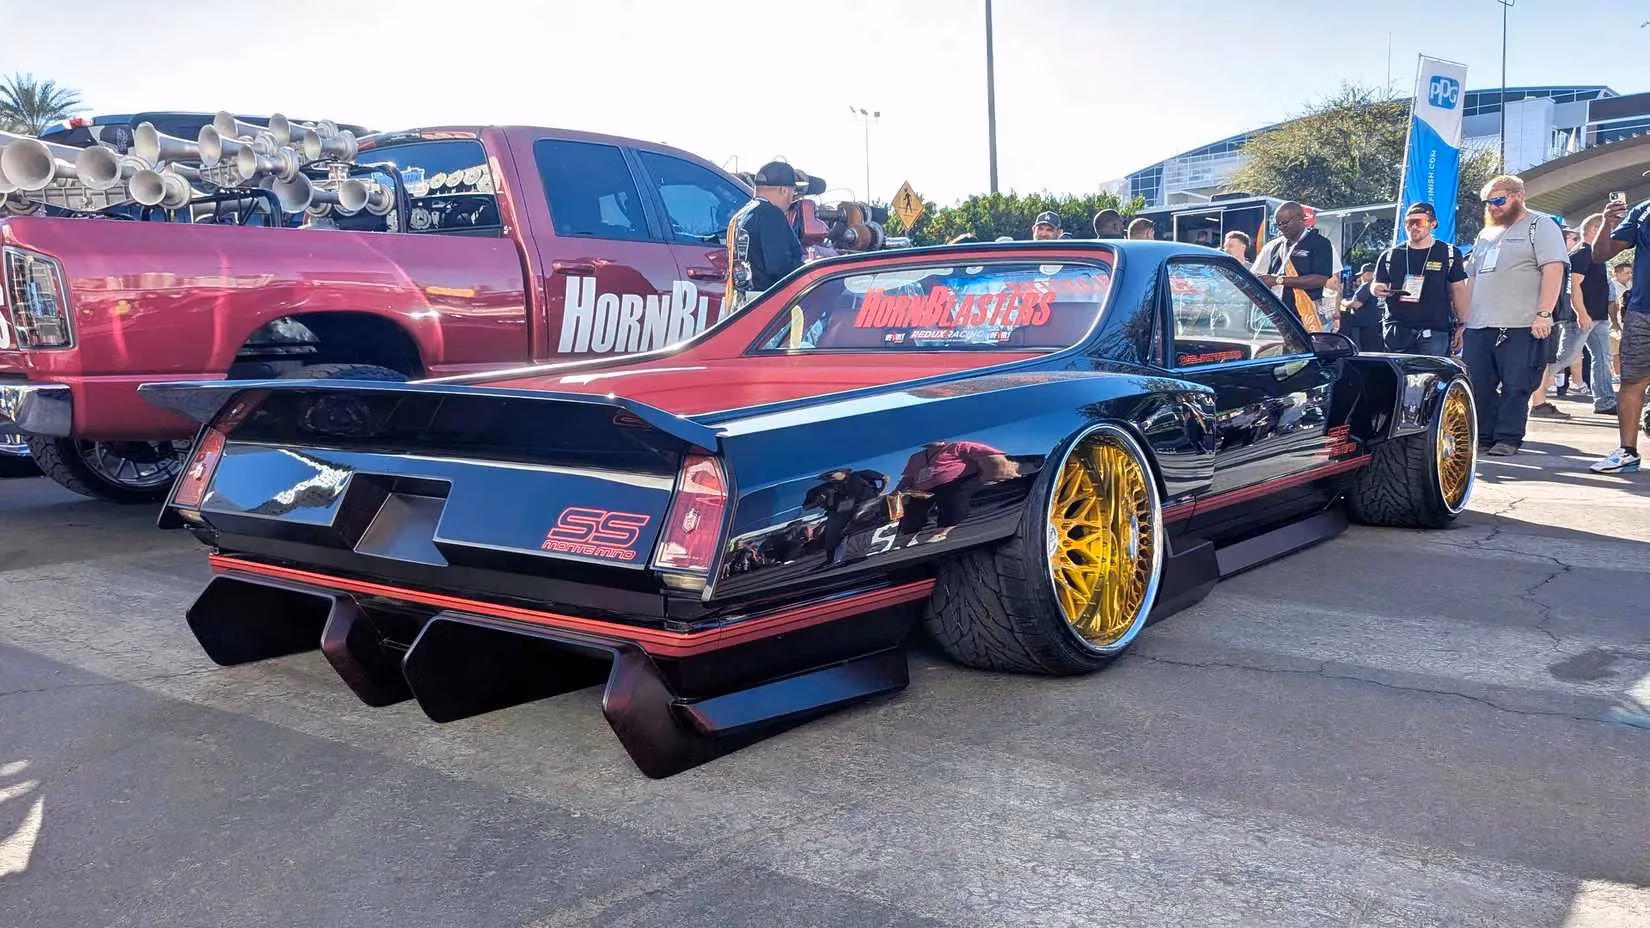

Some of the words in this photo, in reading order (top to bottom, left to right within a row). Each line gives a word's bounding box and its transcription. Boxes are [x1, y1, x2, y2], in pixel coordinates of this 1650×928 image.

[1430, 79, 1458, 105] PPG
[1427, 150, 1437, 204] FINISH.COM
[911, 329, 946, 339] REDUX
[547, 507, 650, 547] SS
